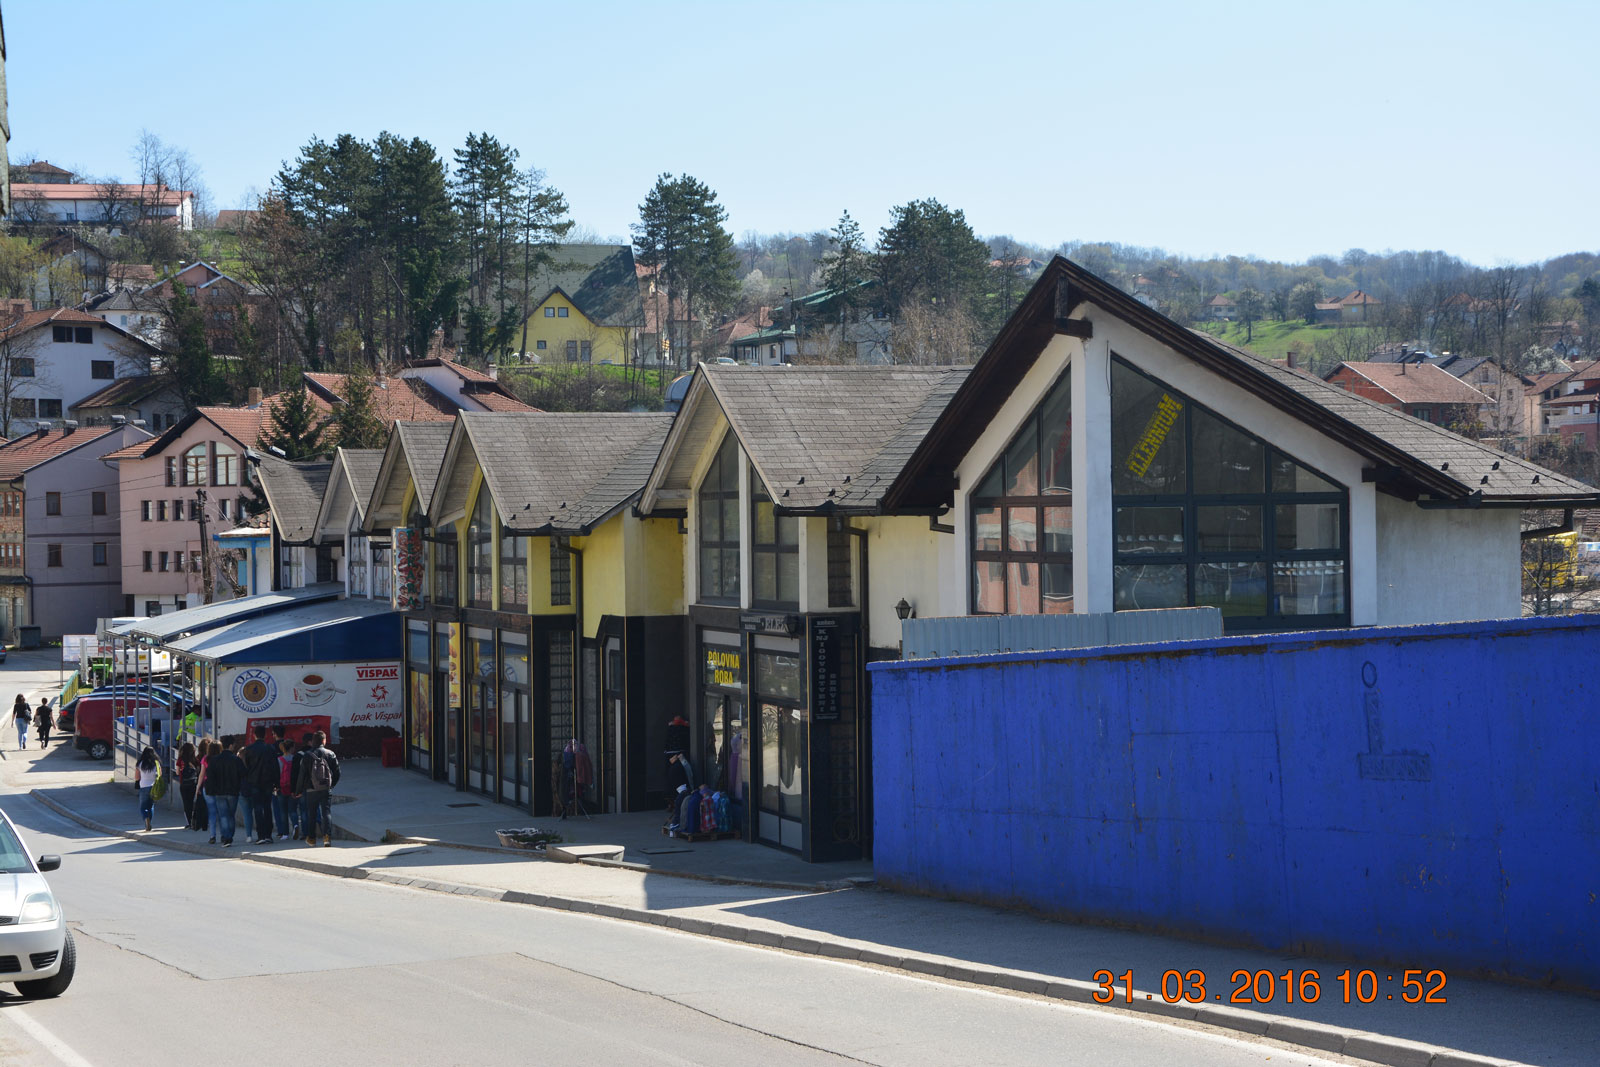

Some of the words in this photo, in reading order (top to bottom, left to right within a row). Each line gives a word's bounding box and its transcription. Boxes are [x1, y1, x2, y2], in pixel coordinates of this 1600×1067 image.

[708, 650, 740, 669] POLOVNA
[235, 669, 272, 685] OAZA
[356, 668, 398, 679] VISPAK
[714, 669, 734, 685] ROBA
[250, 718, 313, 729] espresso
[350, 712, 372, 724] Ipak
